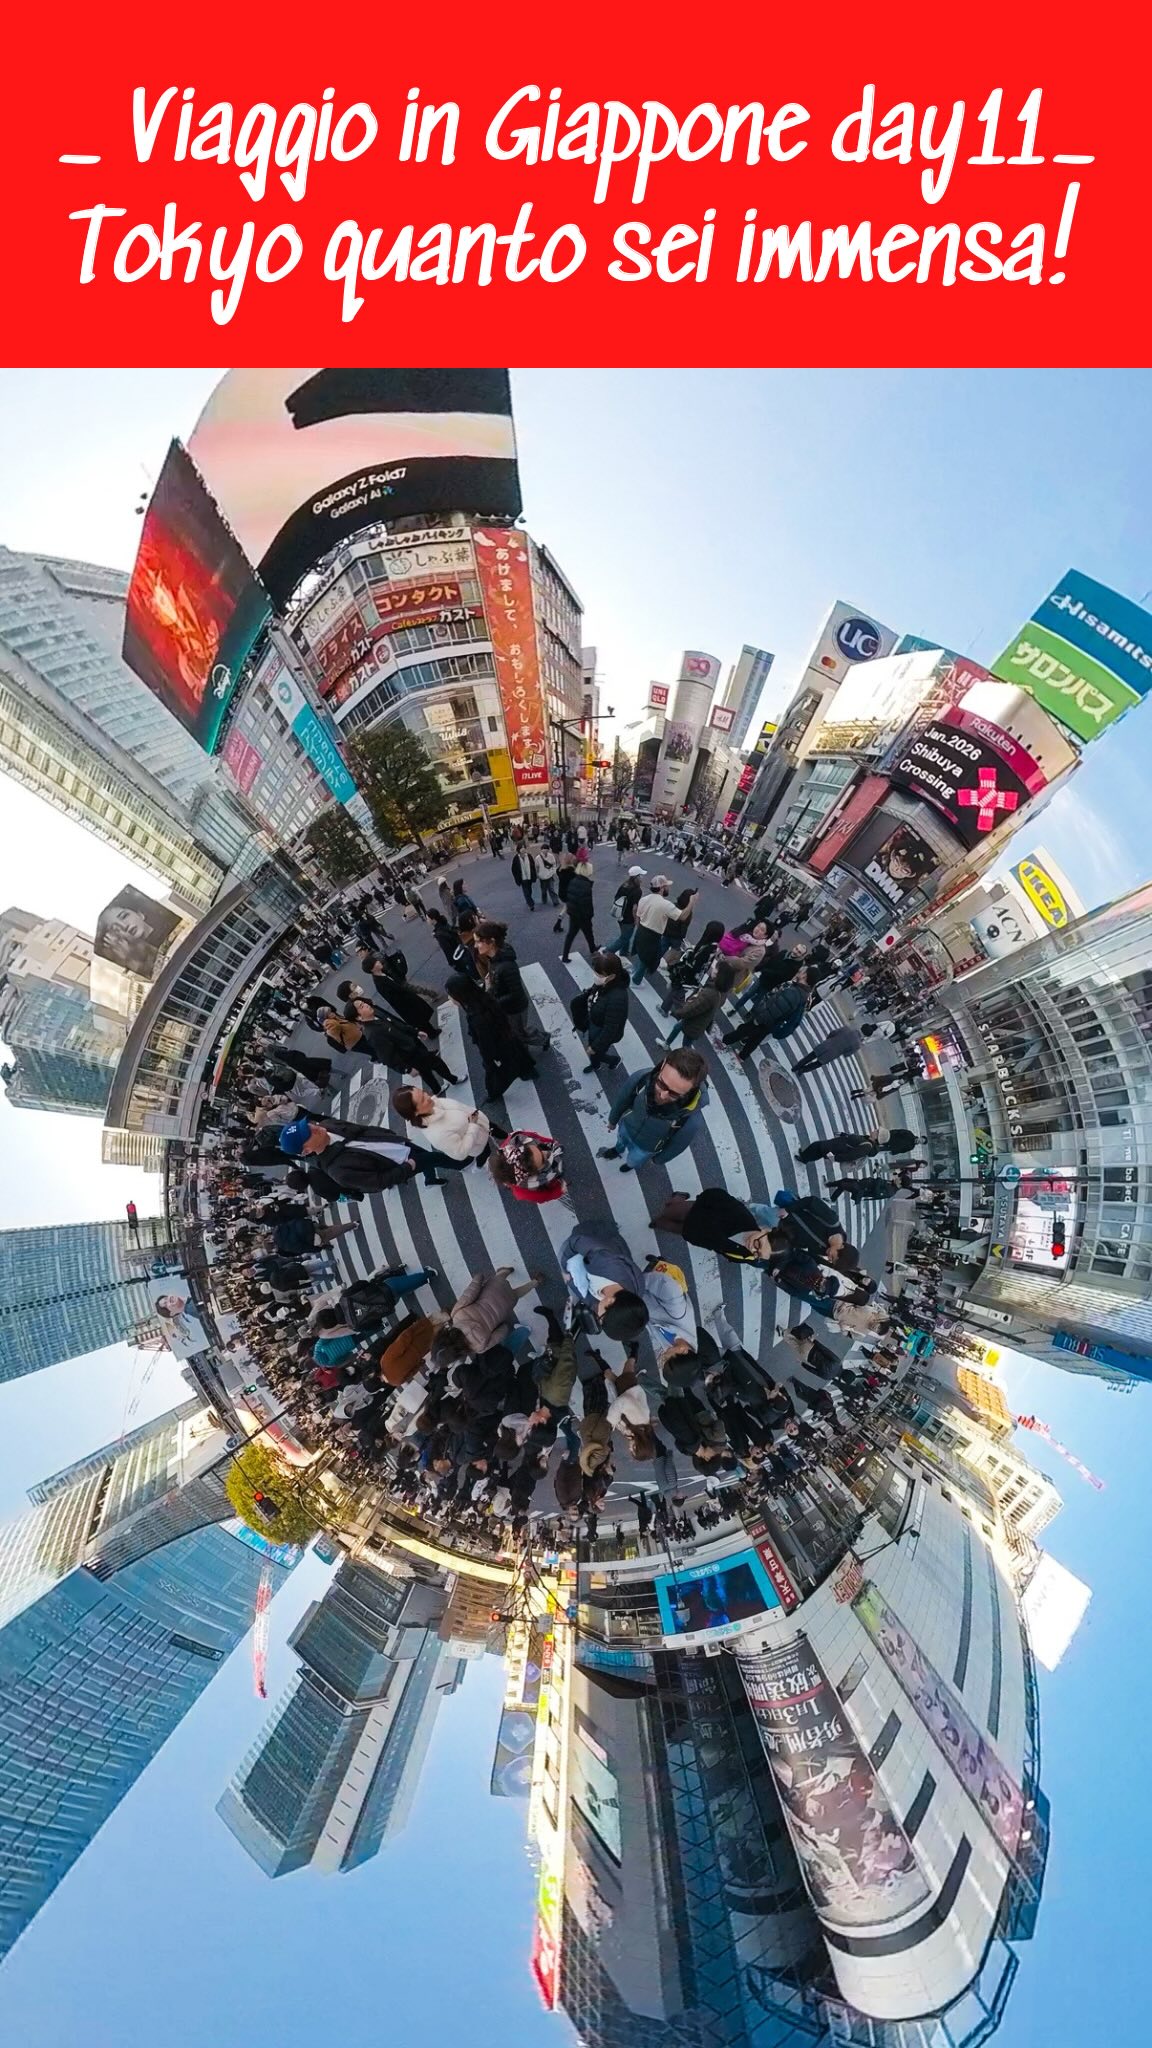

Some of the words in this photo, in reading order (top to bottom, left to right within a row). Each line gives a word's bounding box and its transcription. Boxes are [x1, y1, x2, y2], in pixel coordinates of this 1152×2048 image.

[313, 483, 358, 514] Galaxy
[358, 477, 369, 489] Z
[369, 467, 407, 486] Fold7
[330, 493, 368, 519] Galaxy
[375, 584, 459, 613] コンタクト
[438, 607, 476, 623] ガスト
[840, 622, 879, 657] UC
[1010, 641, 1115, 723] サロンパス
[970, 717, 1017, 756] Rakuten
[899, 758, 956, 800] Crossing
[911, 742, 964, 778] Shibuya
[1022, 865, 1064, 924] IKEA
[979, 1023, 1023, 1136] STARBUCKS
[997, 1195, 1009, 1239] TSUTAYA
